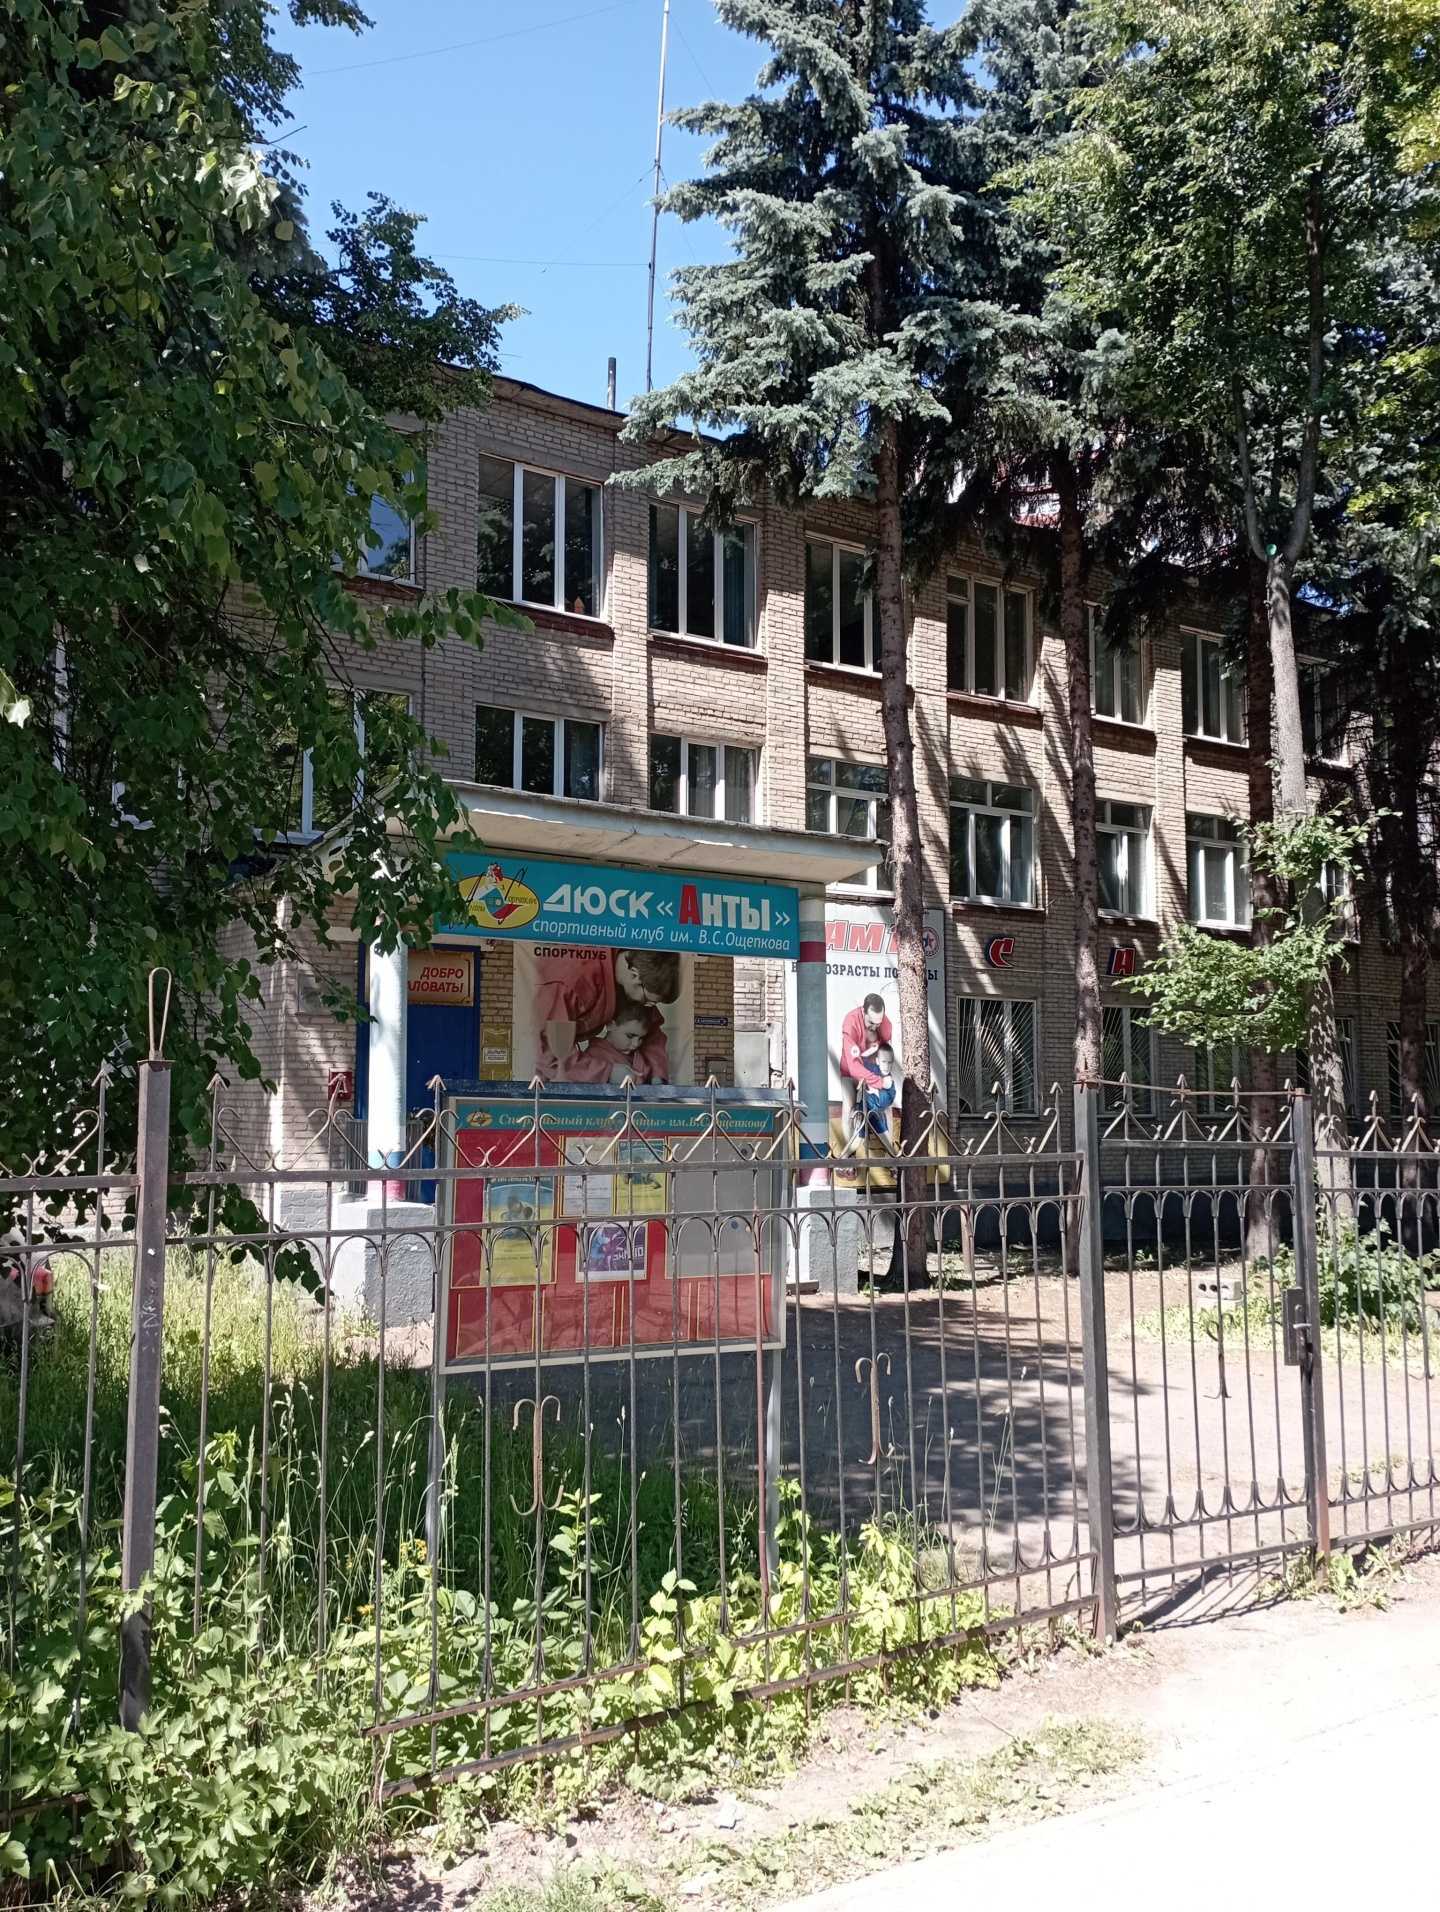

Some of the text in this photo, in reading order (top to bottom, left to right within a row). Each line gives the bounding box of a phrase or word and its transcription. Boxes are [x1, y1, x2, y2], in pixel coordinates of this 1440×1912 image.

[543, 884, 655, 919] ДЮСК
[532, 919, 790, 951] спортивный клуб им. В.С.Ощепкова
[534, 946, 607, 960] СПОРТКЛУБ
[420, 966, 464, 980] ДОБРО
[825, 963, 880, 978] ОЗРАСТЫ
